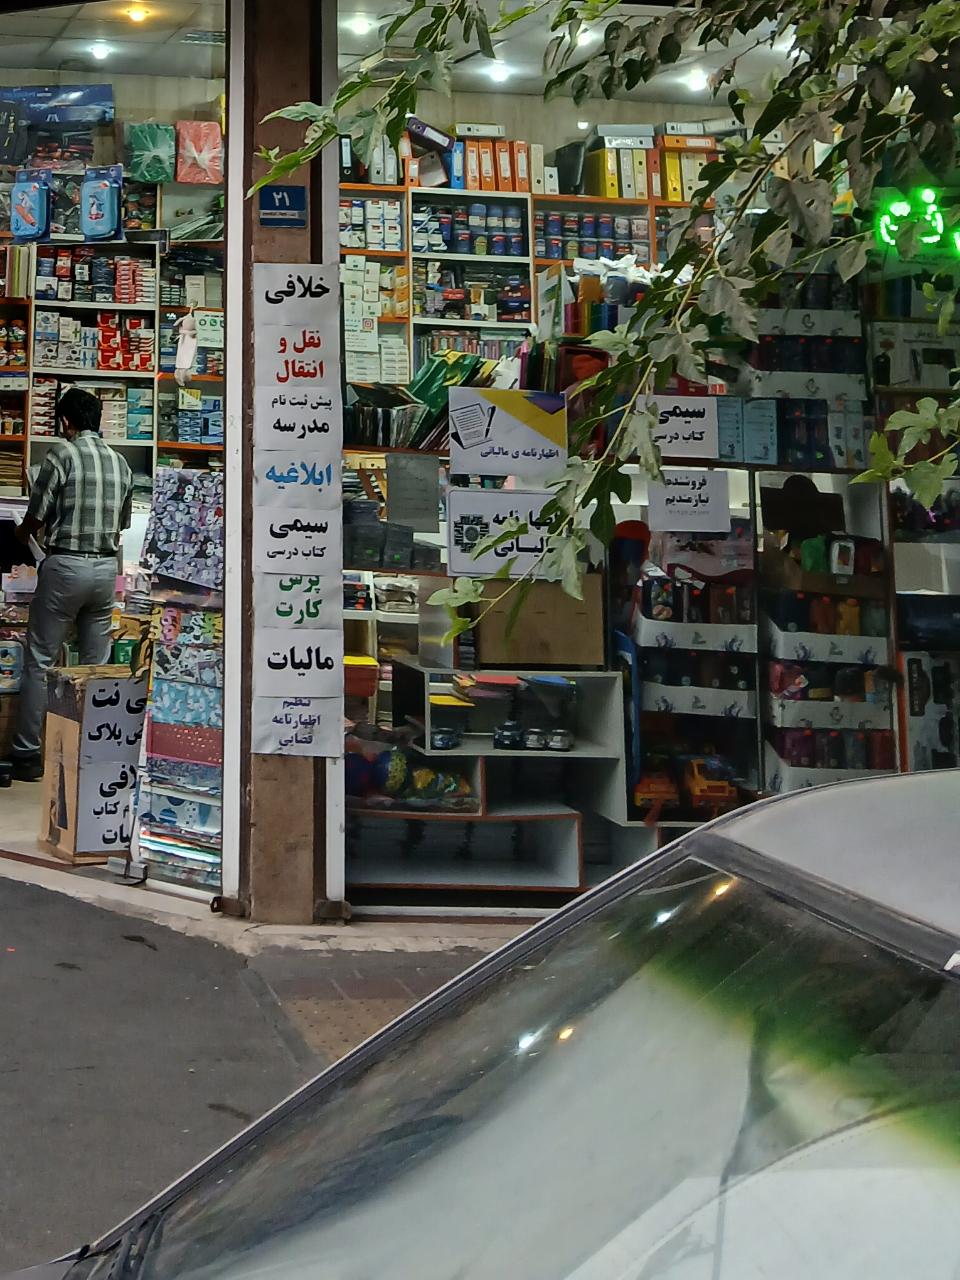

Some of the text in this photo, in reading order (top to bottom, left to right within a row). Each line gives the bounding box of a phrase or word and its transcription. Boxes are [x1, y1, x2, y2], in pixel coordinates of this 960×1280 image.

[265, 274, 330, 304] خلافی
[277, 336, 287, 353] و
[293, 329, 321, 353] نقل
[276, 360, 324, 383] انتقال
[272, 394, 332, 411] پیش ثبت نام
[272, 417, 330, 439] مدرسه
[265, 461, 332, 492] ابلاغیه
[269, 519, 328, 539] سیمی
[267, 545, 327, 560] کتاب درسی
[279, 575, 321, 594] پرس
[276, 598, 322, 625] کارت
[267, 646, 334, 676] مالیات
[92, 682, 120, 709] نت
[88, 723, 122, 746] پلاک
[93, 801, 121, 819] کتاب
